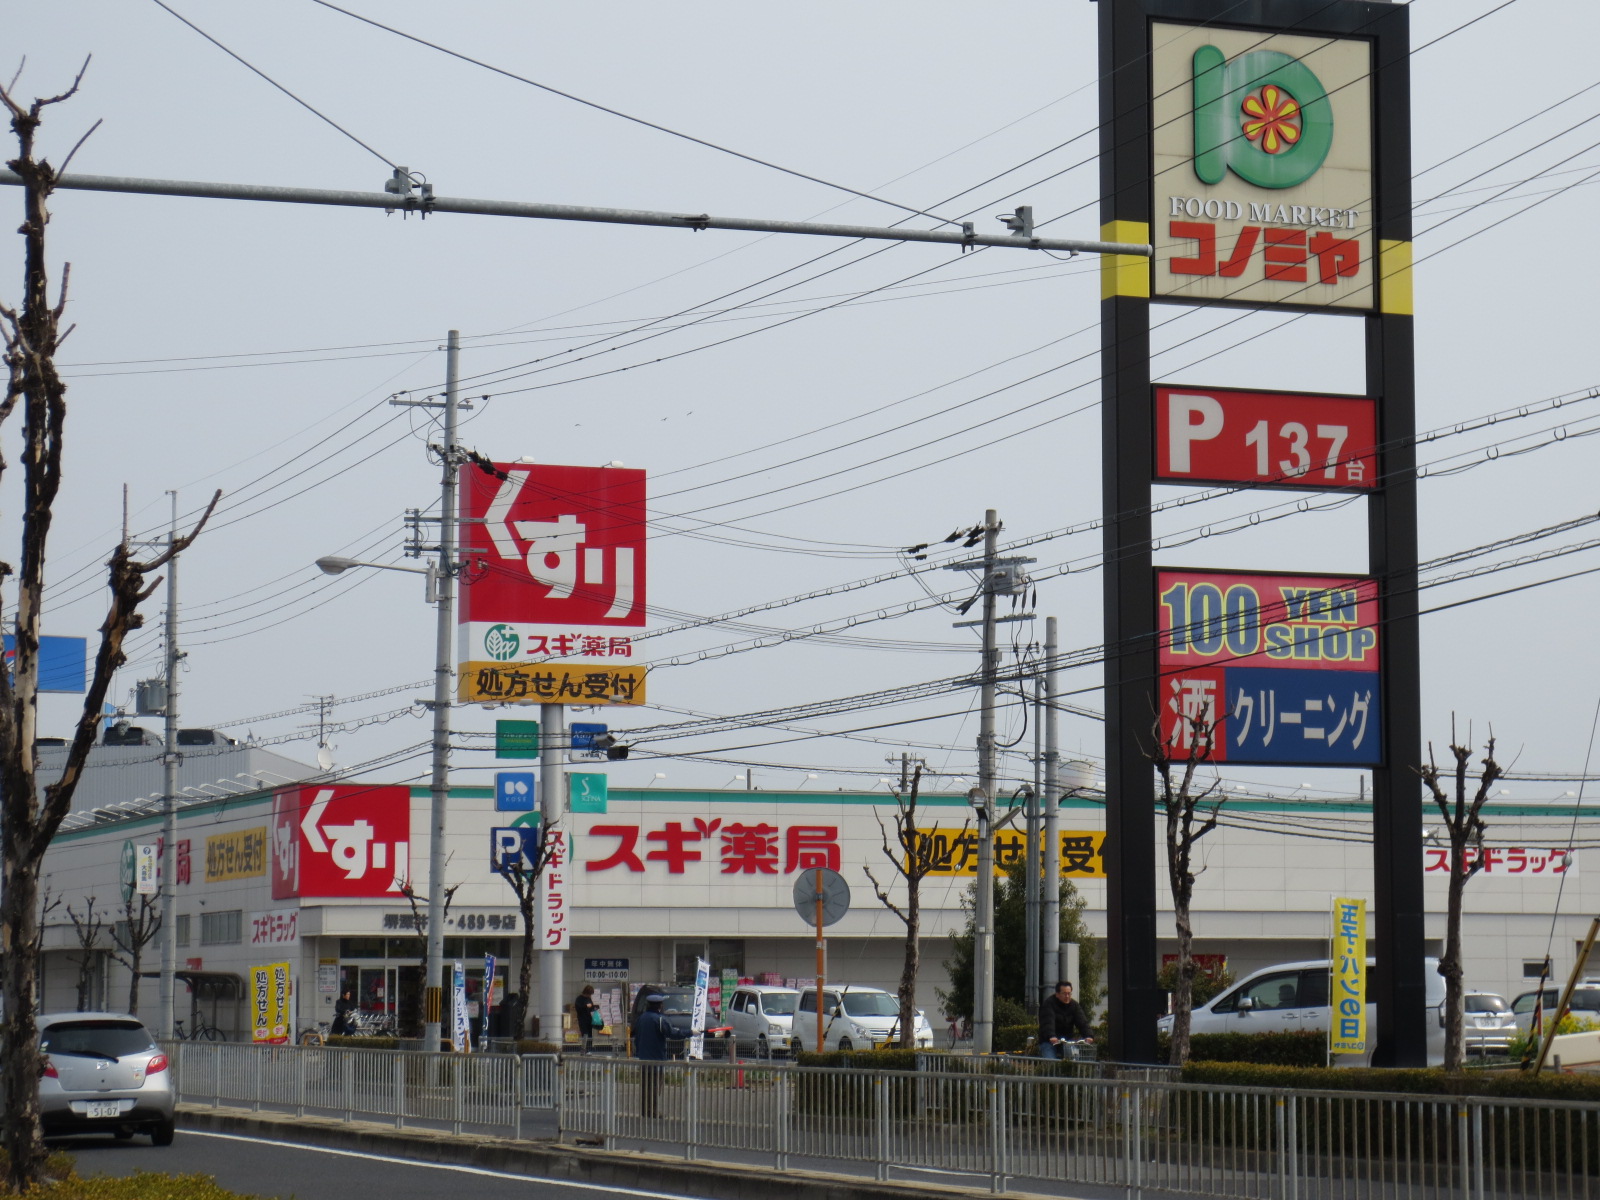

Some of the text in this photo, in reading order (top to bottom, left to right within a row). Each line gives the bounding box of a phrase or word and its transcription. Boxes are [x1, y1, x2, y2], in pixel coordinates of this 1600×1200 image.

[1169, 196, 1360, 229] FOOD MARKET
[1169, 220, 1361, 285] コノミヤ
[1168, 393, 1225, 473] P
[483, 469, 635, 619] くすり
[526, 632, 632, 658] スギ薬局
[1160, 581, 1358, 657] 100 YEN
[1264, 623, 1377, 662] SHOP
[476, 669, 637, 700] 処方せん受付
[1168, 677, 1217, 751] 酒
[1234, 687, 1371, 750] クリーニング
[207, 832, 263, 878] 処方せん受付
[272, 794, 299, 891] くすり
[300, 789, 408, 892] くすり
[495, 829, 521, 865] P
[585, 817, 841, 875] スギ薬局
[546, 831, 567, 946] スギドラッグ
[252, 912, 298, 944] スギドラッグ
[256, 971, 267, 1027] 処方せん
[275, 968, 285, 1025] 処方せん
